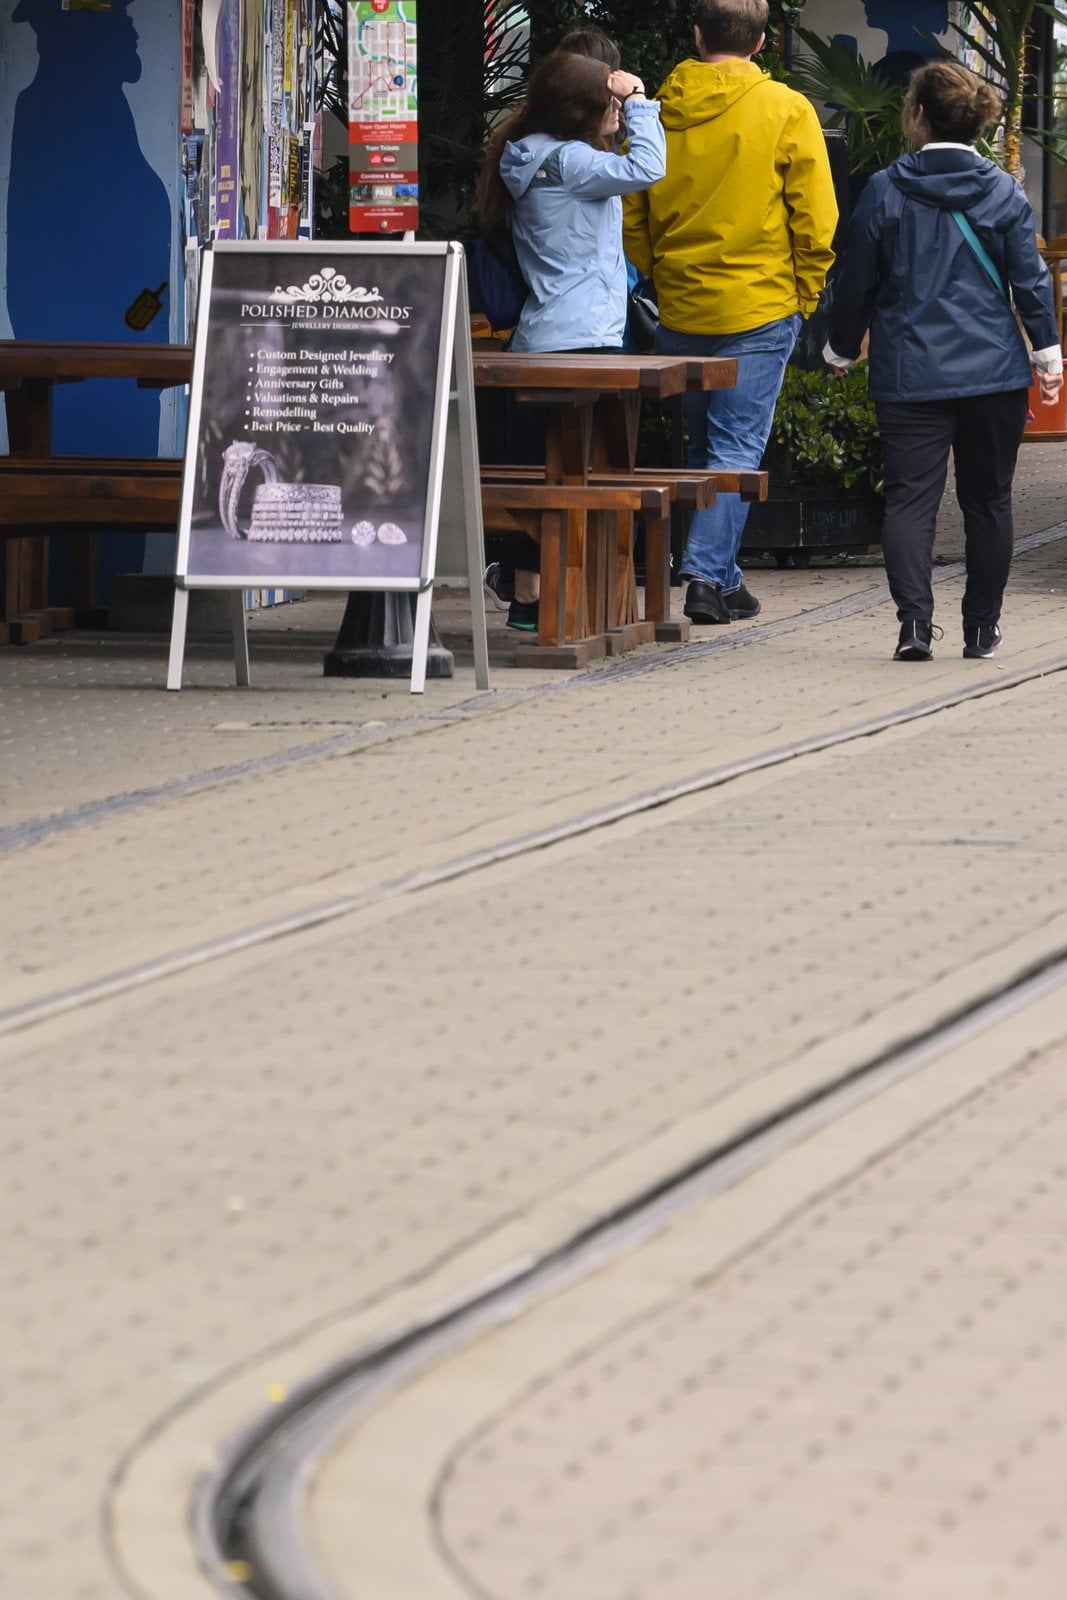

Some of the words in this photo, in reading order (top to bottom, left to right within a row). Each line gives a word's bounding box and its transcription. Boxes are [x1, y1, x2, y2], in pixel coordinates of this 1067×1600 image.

[375, 186, 393, 197] PASS
[240, 304, 318, 318] POLISHED
[322, 306, 411, 319] DIAMONDS
[291, 322, 331, 330] JEWELLERY
[257, 350, 297, 360] Custom
[299, 350, 347, 363] Designed
[349, 351, 394, 364] Jewellery
[256, 364, 318, 377] Engagement
[320, 365, 330, 374] &
[333, 364, 378, 378] Wedding
[254, 379, 317, 391] Anniversary
[319, 379, 344, 389] Gifts
[254, 393, 307, 403] Valuations
[309, 394, 318, 403] &
[321, 394, 359, 406] Repairs
[252, 407, 317, 419] Remodelling
[251, 422, 273, 431] Best
[275, 422, 302, 432] Price
[313, 422, 334, 432] Best
[336, 423, 376, 435] Quality
